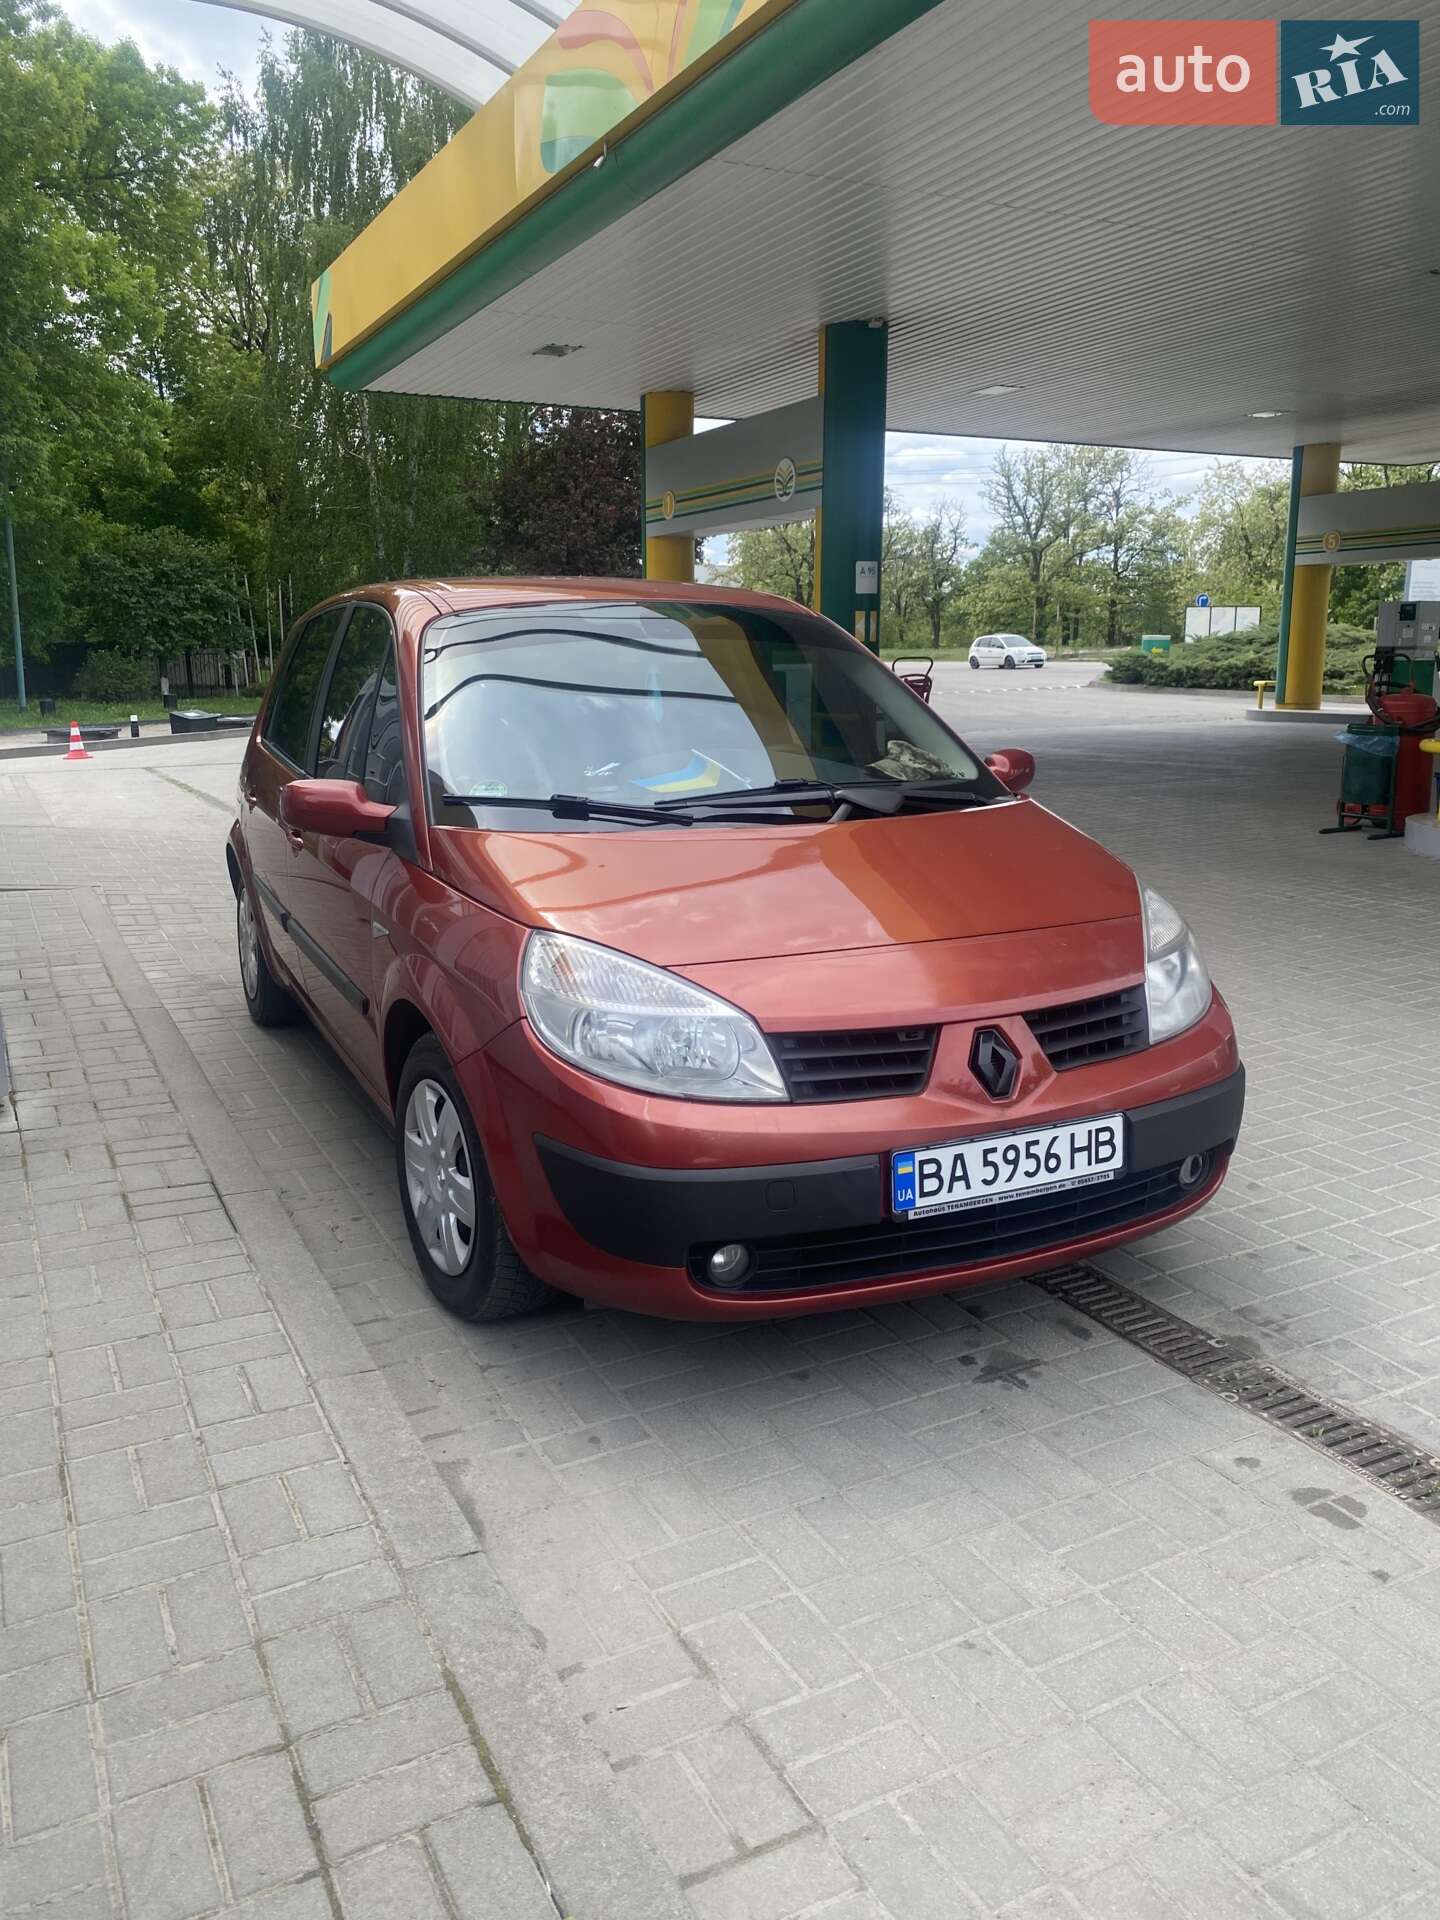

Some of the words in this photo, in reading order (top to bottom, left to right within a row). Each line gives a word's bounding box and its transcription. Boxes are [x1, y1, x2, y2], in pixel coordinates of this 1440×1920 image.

[918, 1153, 971, 1198] BA
[981, 1135, 1061, 1186] 5956
[1070, 1125, 1117, 1170] HB
[897, 1189, 914, 1202] UA
[913, 1206, 946, 1217] Autohaus
